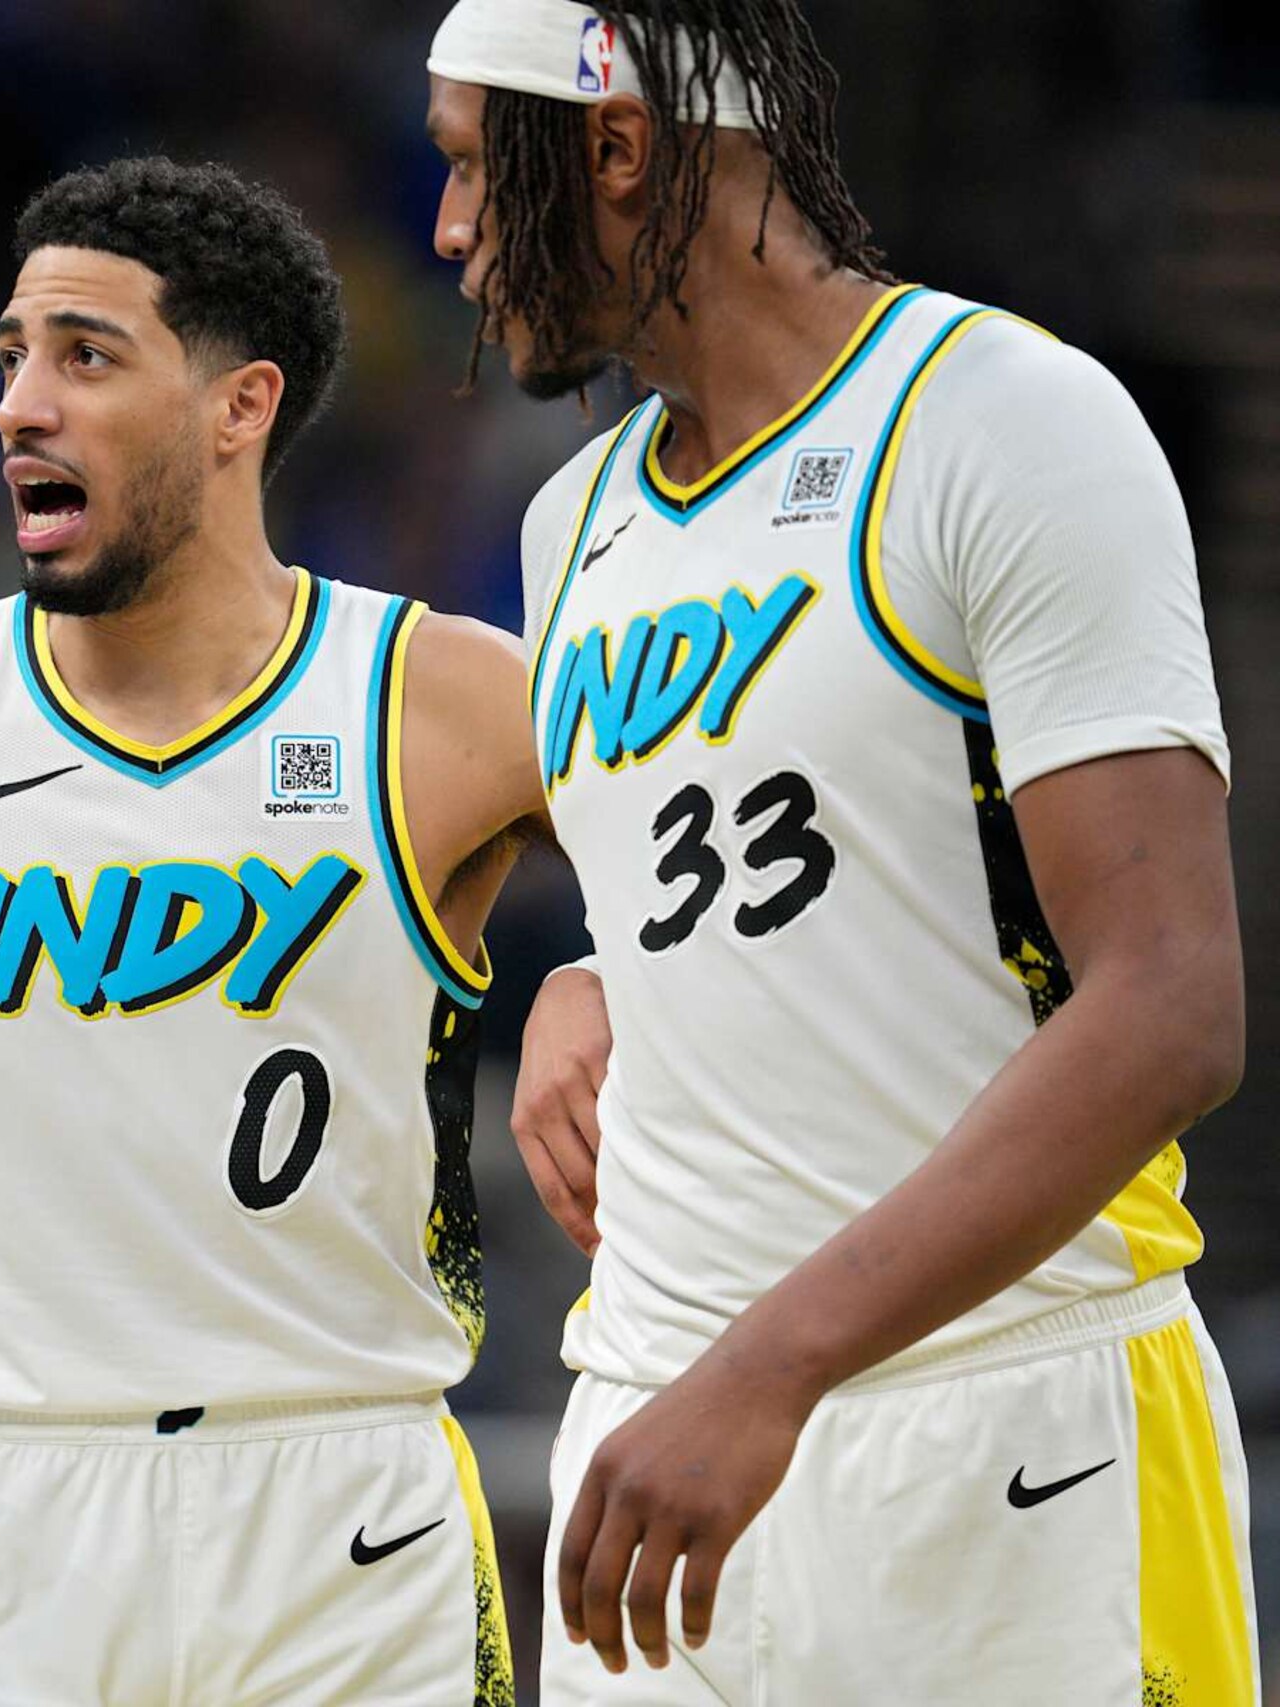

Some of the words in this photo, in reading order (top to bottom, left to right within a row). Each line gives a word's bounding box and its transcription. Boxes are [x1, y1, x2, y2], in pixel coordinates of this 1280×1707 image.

[544, 568, 822, 803] INDY
[265, 800, 349, 817] spokenote
[638, 770, 836, 953] 33
[226, 1047, 331, 1211] 0
